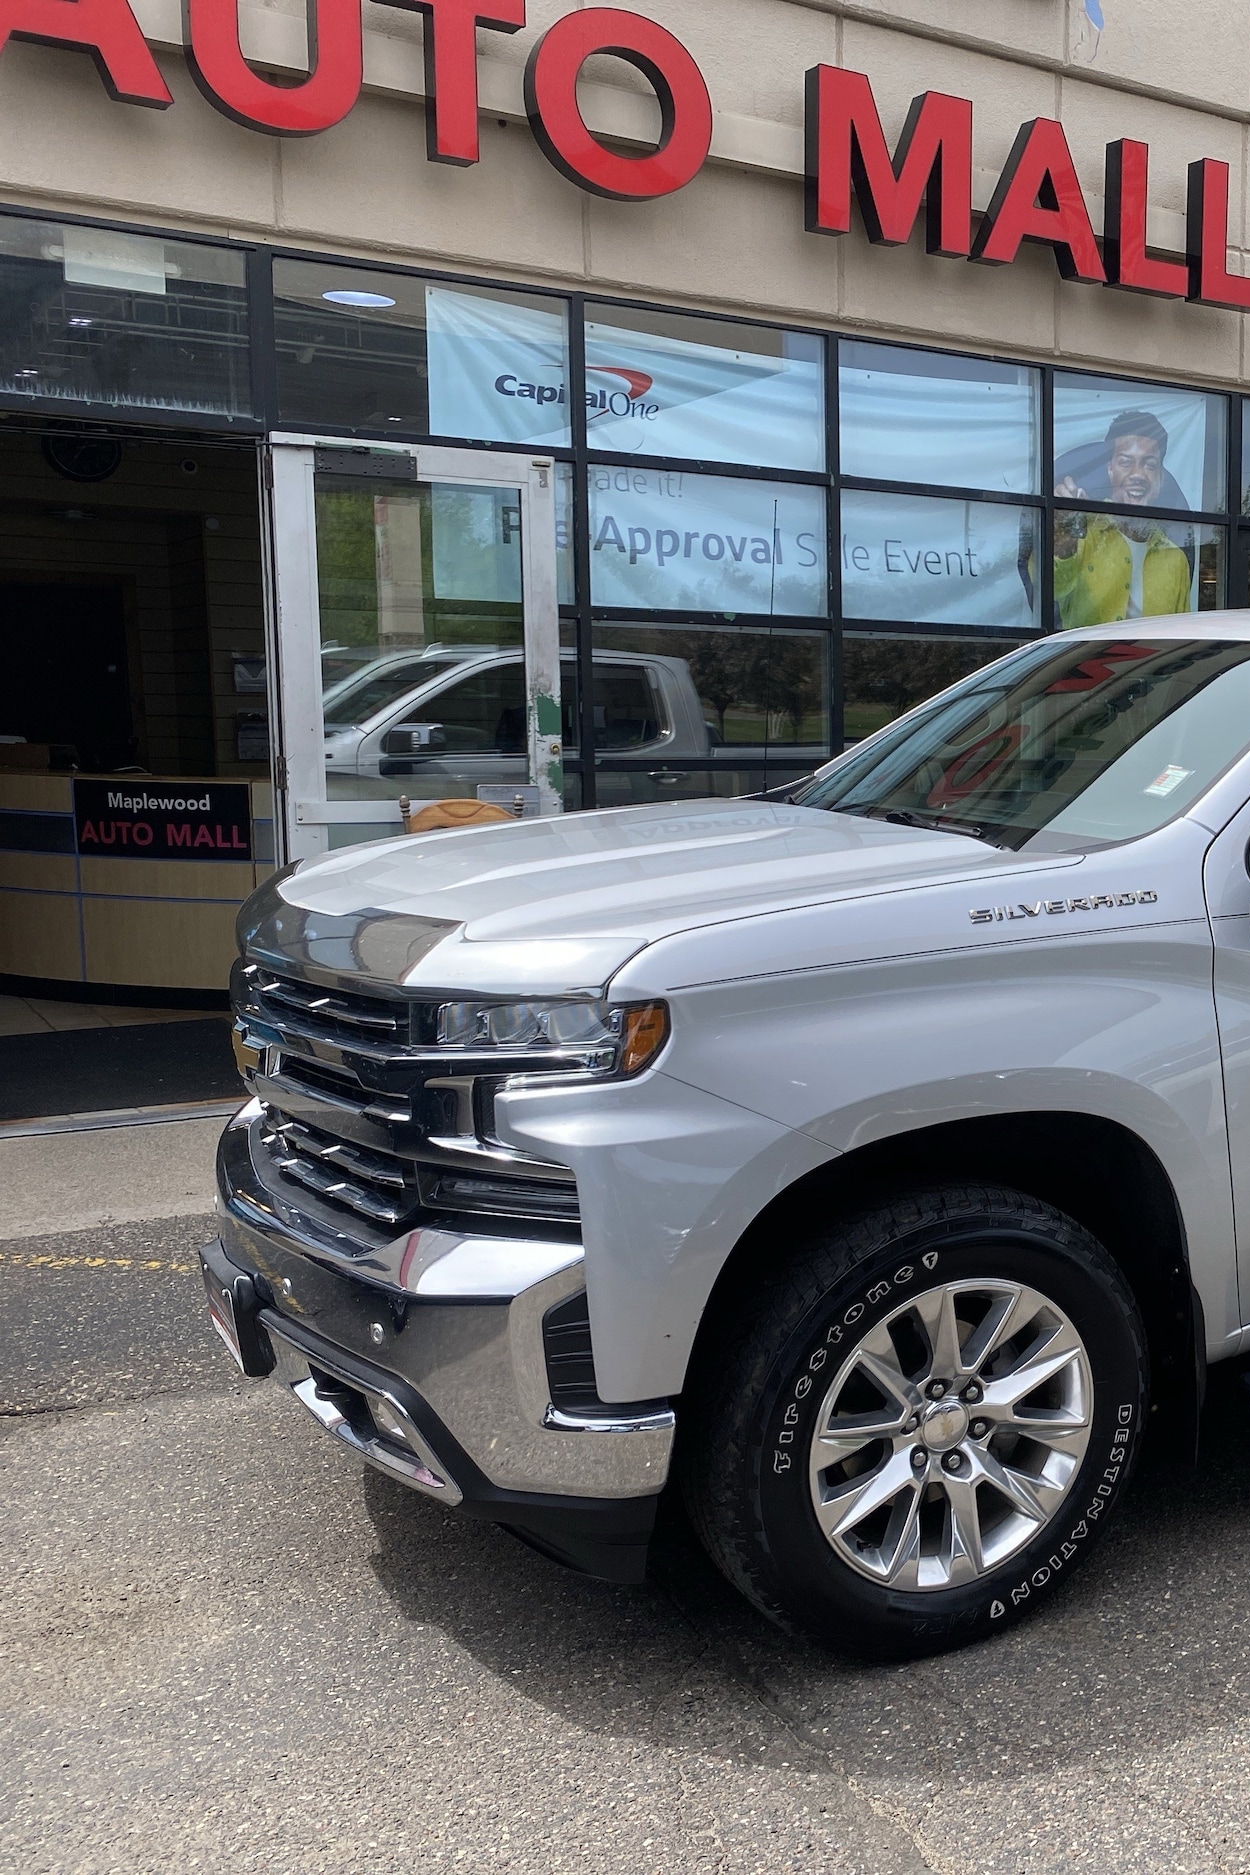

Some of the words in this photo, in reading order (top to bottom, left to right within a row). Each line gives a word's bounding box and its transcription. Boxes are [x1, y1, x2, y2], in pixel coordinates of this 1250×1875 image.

[494, 374, 606, 410] Capial
[795, 532, 871, 572] Sle
[884, 539, 979, 577] Event
[107, 792, 211, 814] Maplewood
[81, 820, 154, 846] AUTO
[167, 823, 248, 848] MALL
[968, 889, 1159, 925] SILVERADO
[772, 1264, 914, 1476] Firestone
[1010, 1403, 1134, 1607] DESTINATION
